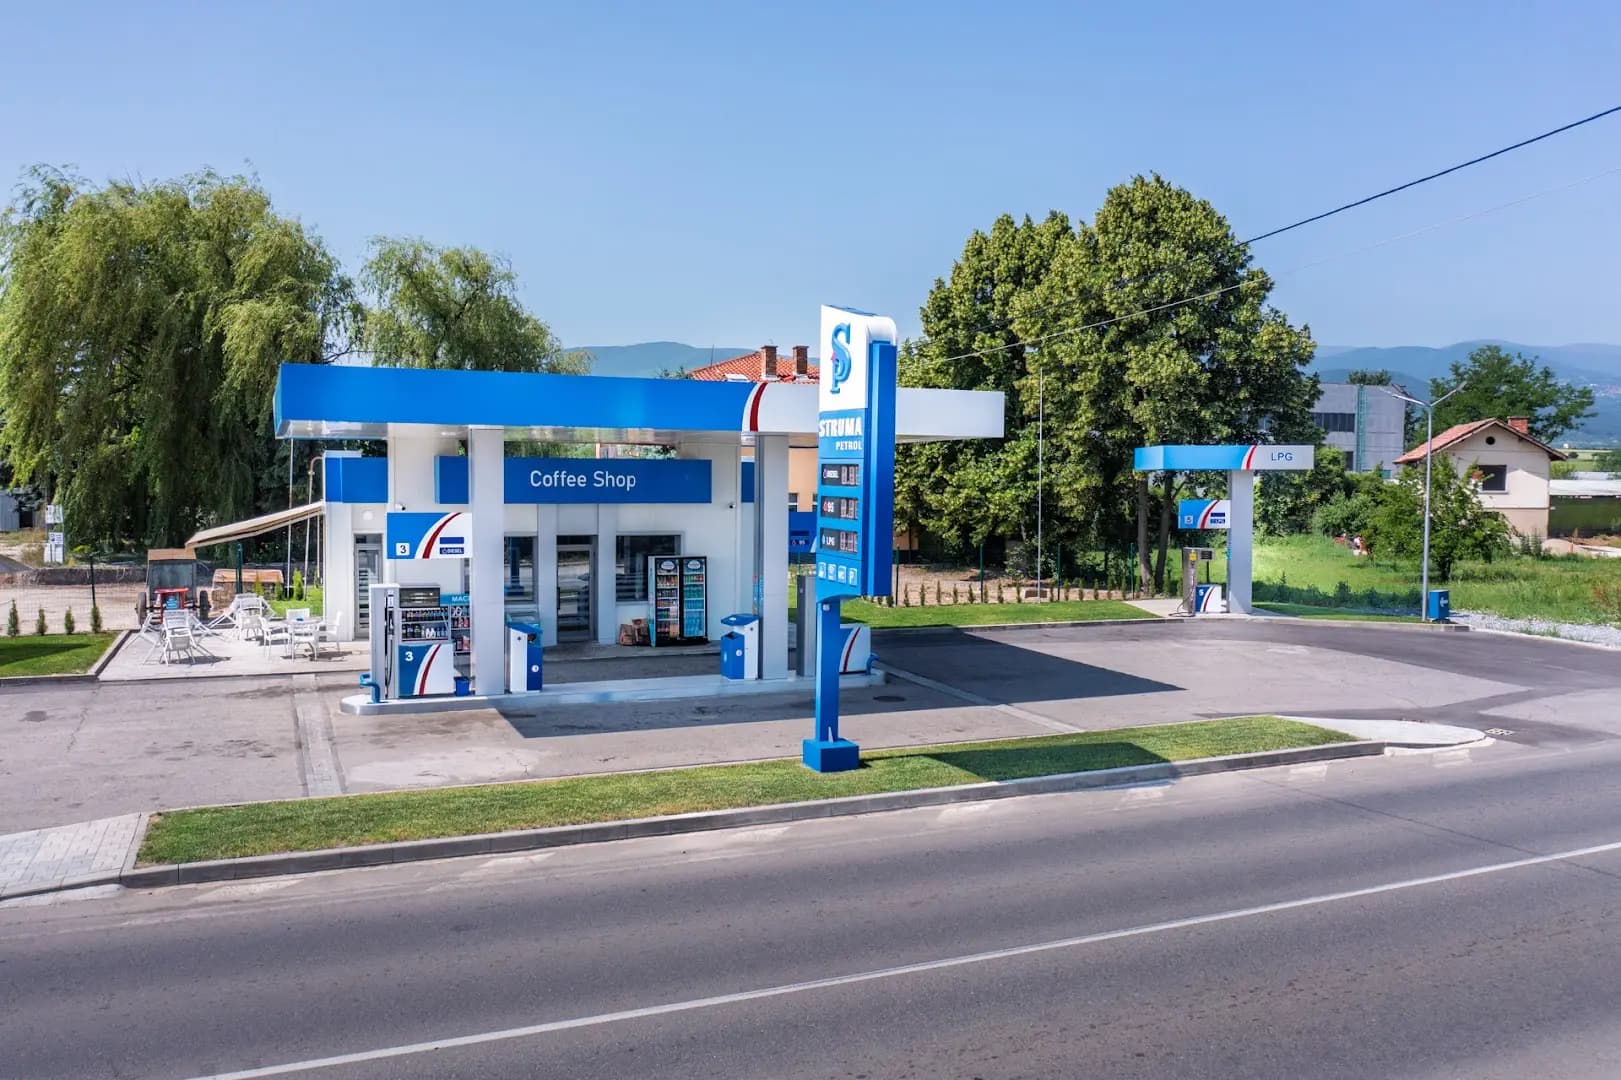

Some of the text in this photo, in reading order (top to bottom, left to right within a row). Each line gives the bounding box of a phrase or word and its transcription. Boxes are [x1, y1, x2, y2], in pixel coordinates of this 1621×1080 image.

[819, 416, 862, 438] STRUMA
[835, 439, 862, 451] PETROL
[1270, 452, 1293, 462] LPG
[529, 469, 636, 491] Coffee Shop
[826, 536, 835, 546] LPG
[399, 545, 407, 554] 3
[404, 651, 414, 662] 3
